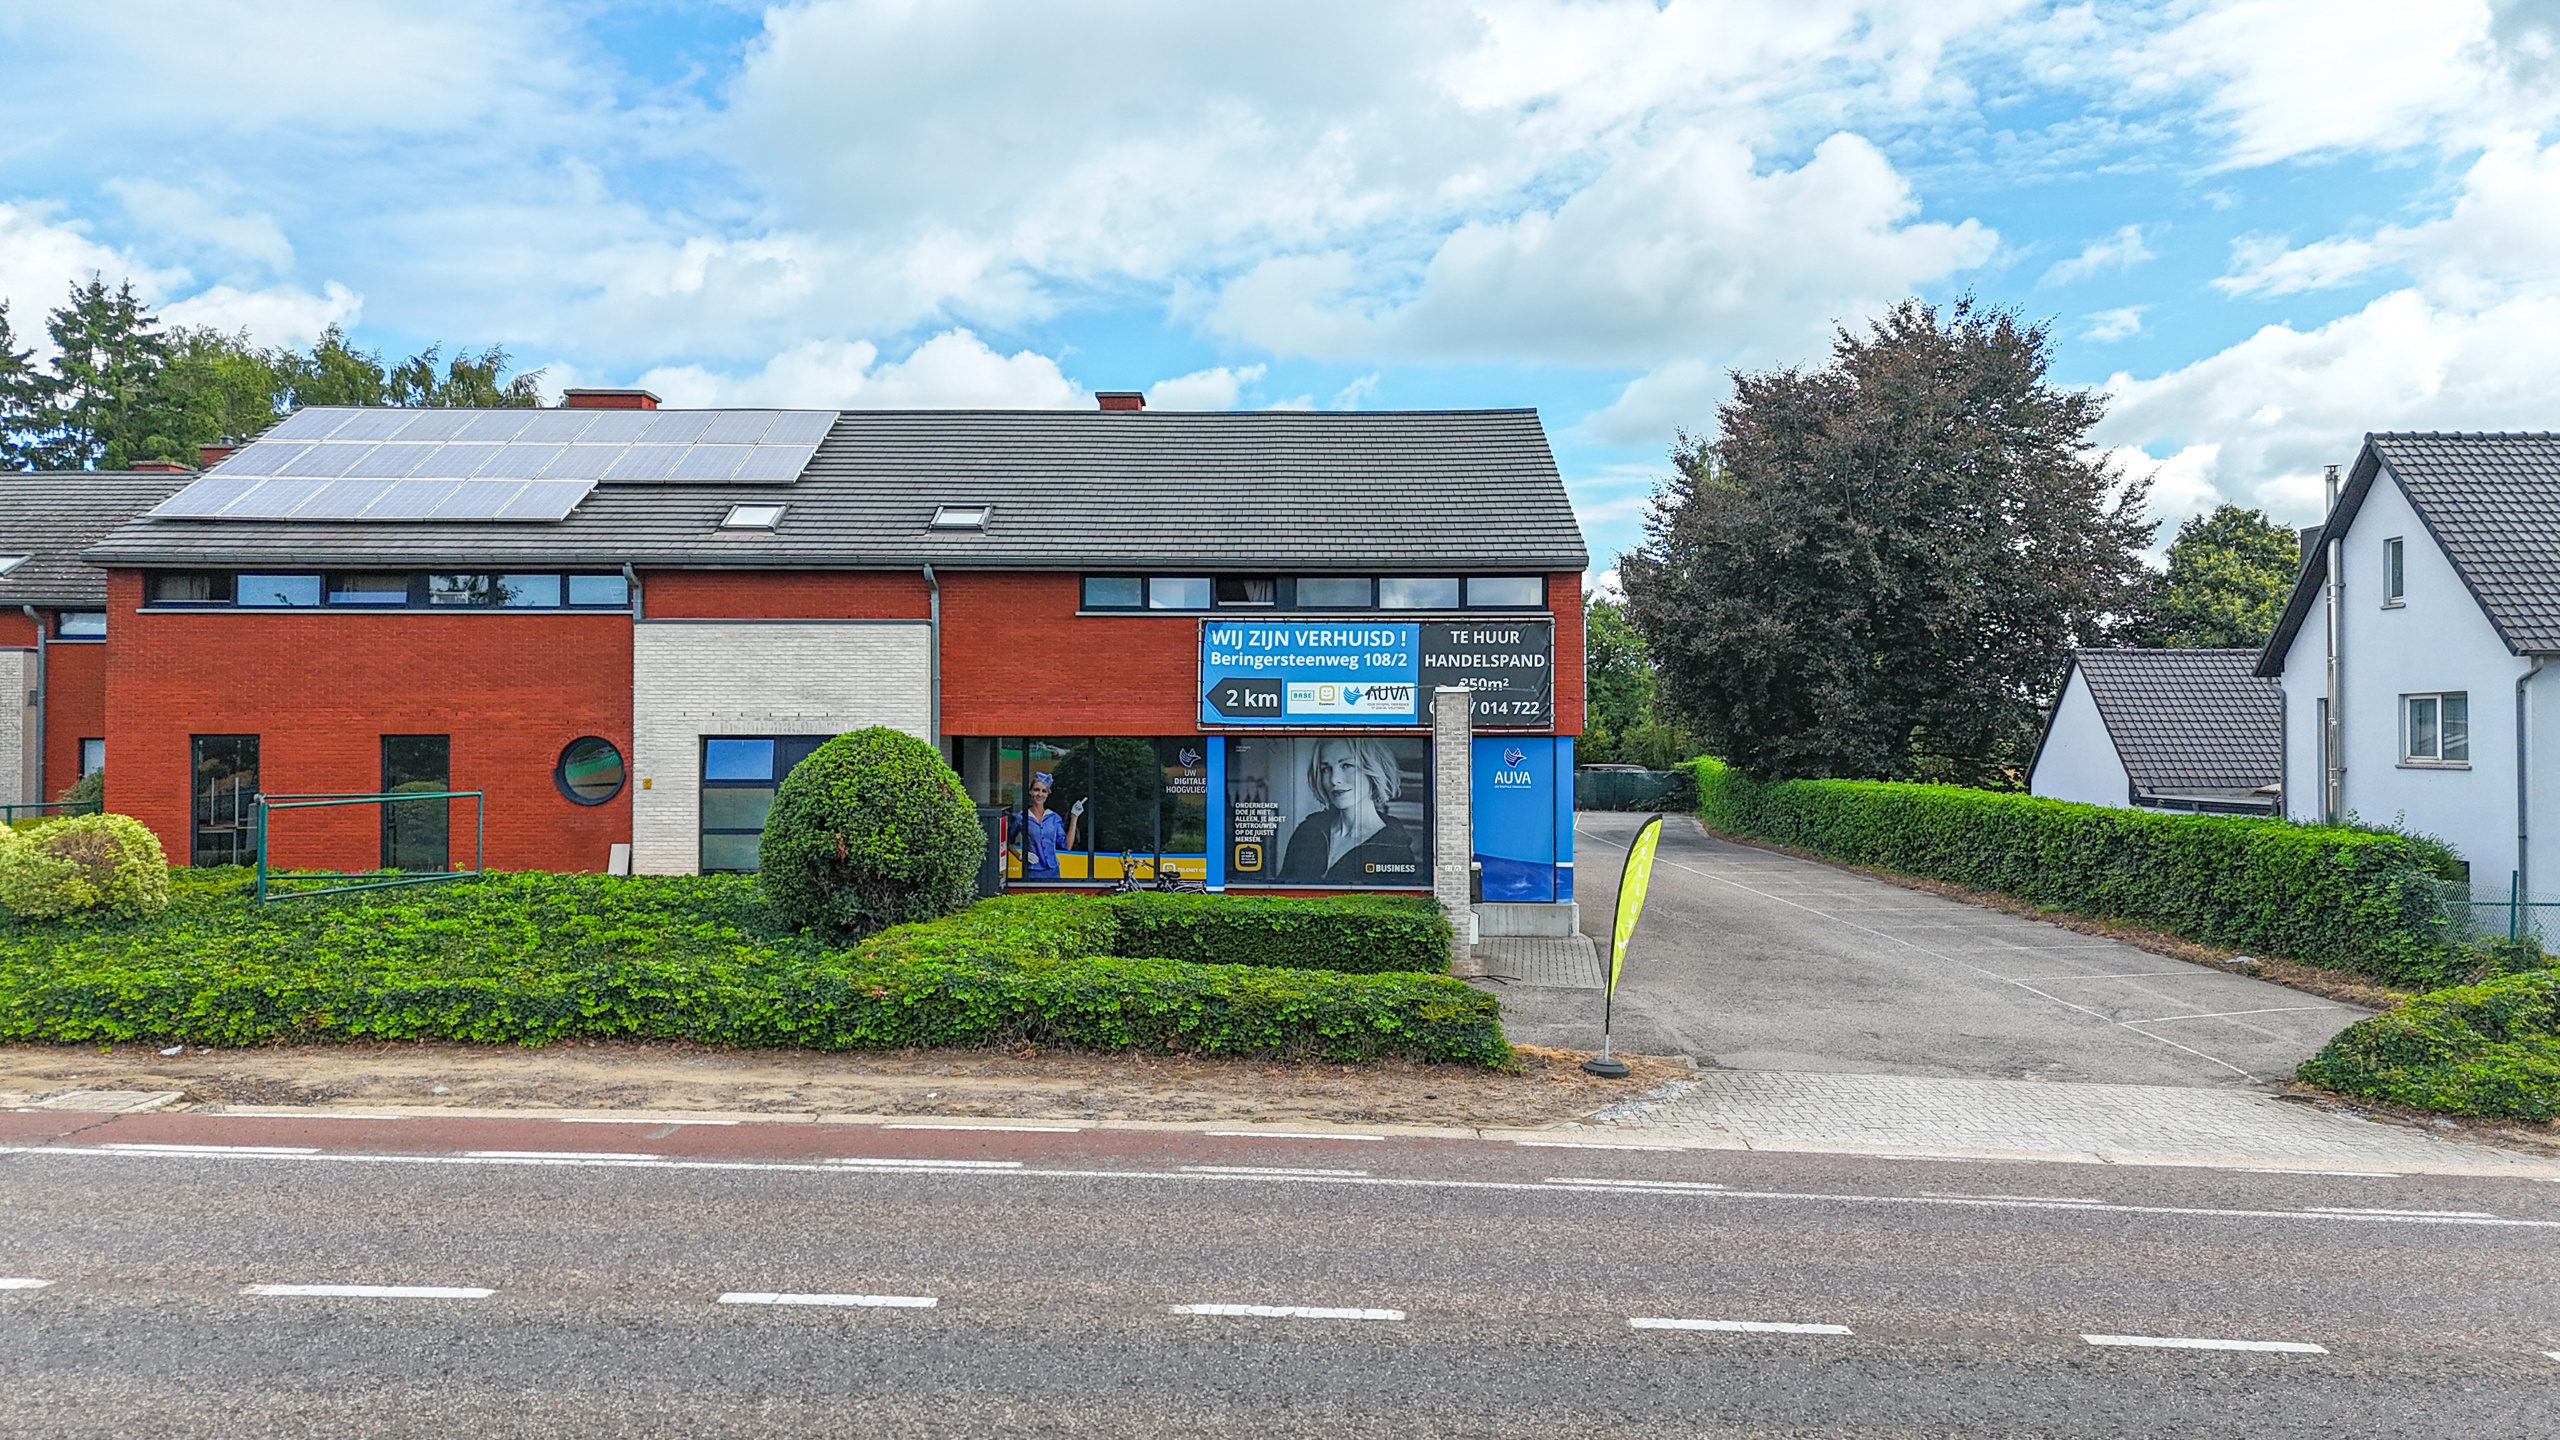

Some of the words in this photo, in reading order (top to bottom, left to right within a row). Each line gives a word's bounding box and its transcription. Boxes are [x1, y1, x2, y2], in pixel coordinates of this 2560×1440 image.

[1212, 630, 1243, 650] WIJ
[1249, 630, 1289, 650] ZIJN
[1295, 630, 1395, 647] VERHUISD
[1401, 630, 1408, 647] !
[1450, 630, 1469, 644] TE
[1473, 630, 1521, 644] HUUR
[1211, 652, 1359, 670] Beringersteenweg
[1363, 653, 1408, 667] 108/2
[1425, 654, 1545, 668] HANDELSPAND
[1226, 689, 1239, 707] 2
[1244, 688, 1278, 707] km
[1366, 685, 1410, 701] AUVA
[1480, 702, 1509, 715] 014
[1511, 702, 1540, 715] 722
[1184, 769, 1197, 777] UW
[1494, 771, 1531, 784] AUVA
[1174, 777, 1207, 785] DIGITALE
[1375, 864, 1416, 873] BUSINESS
